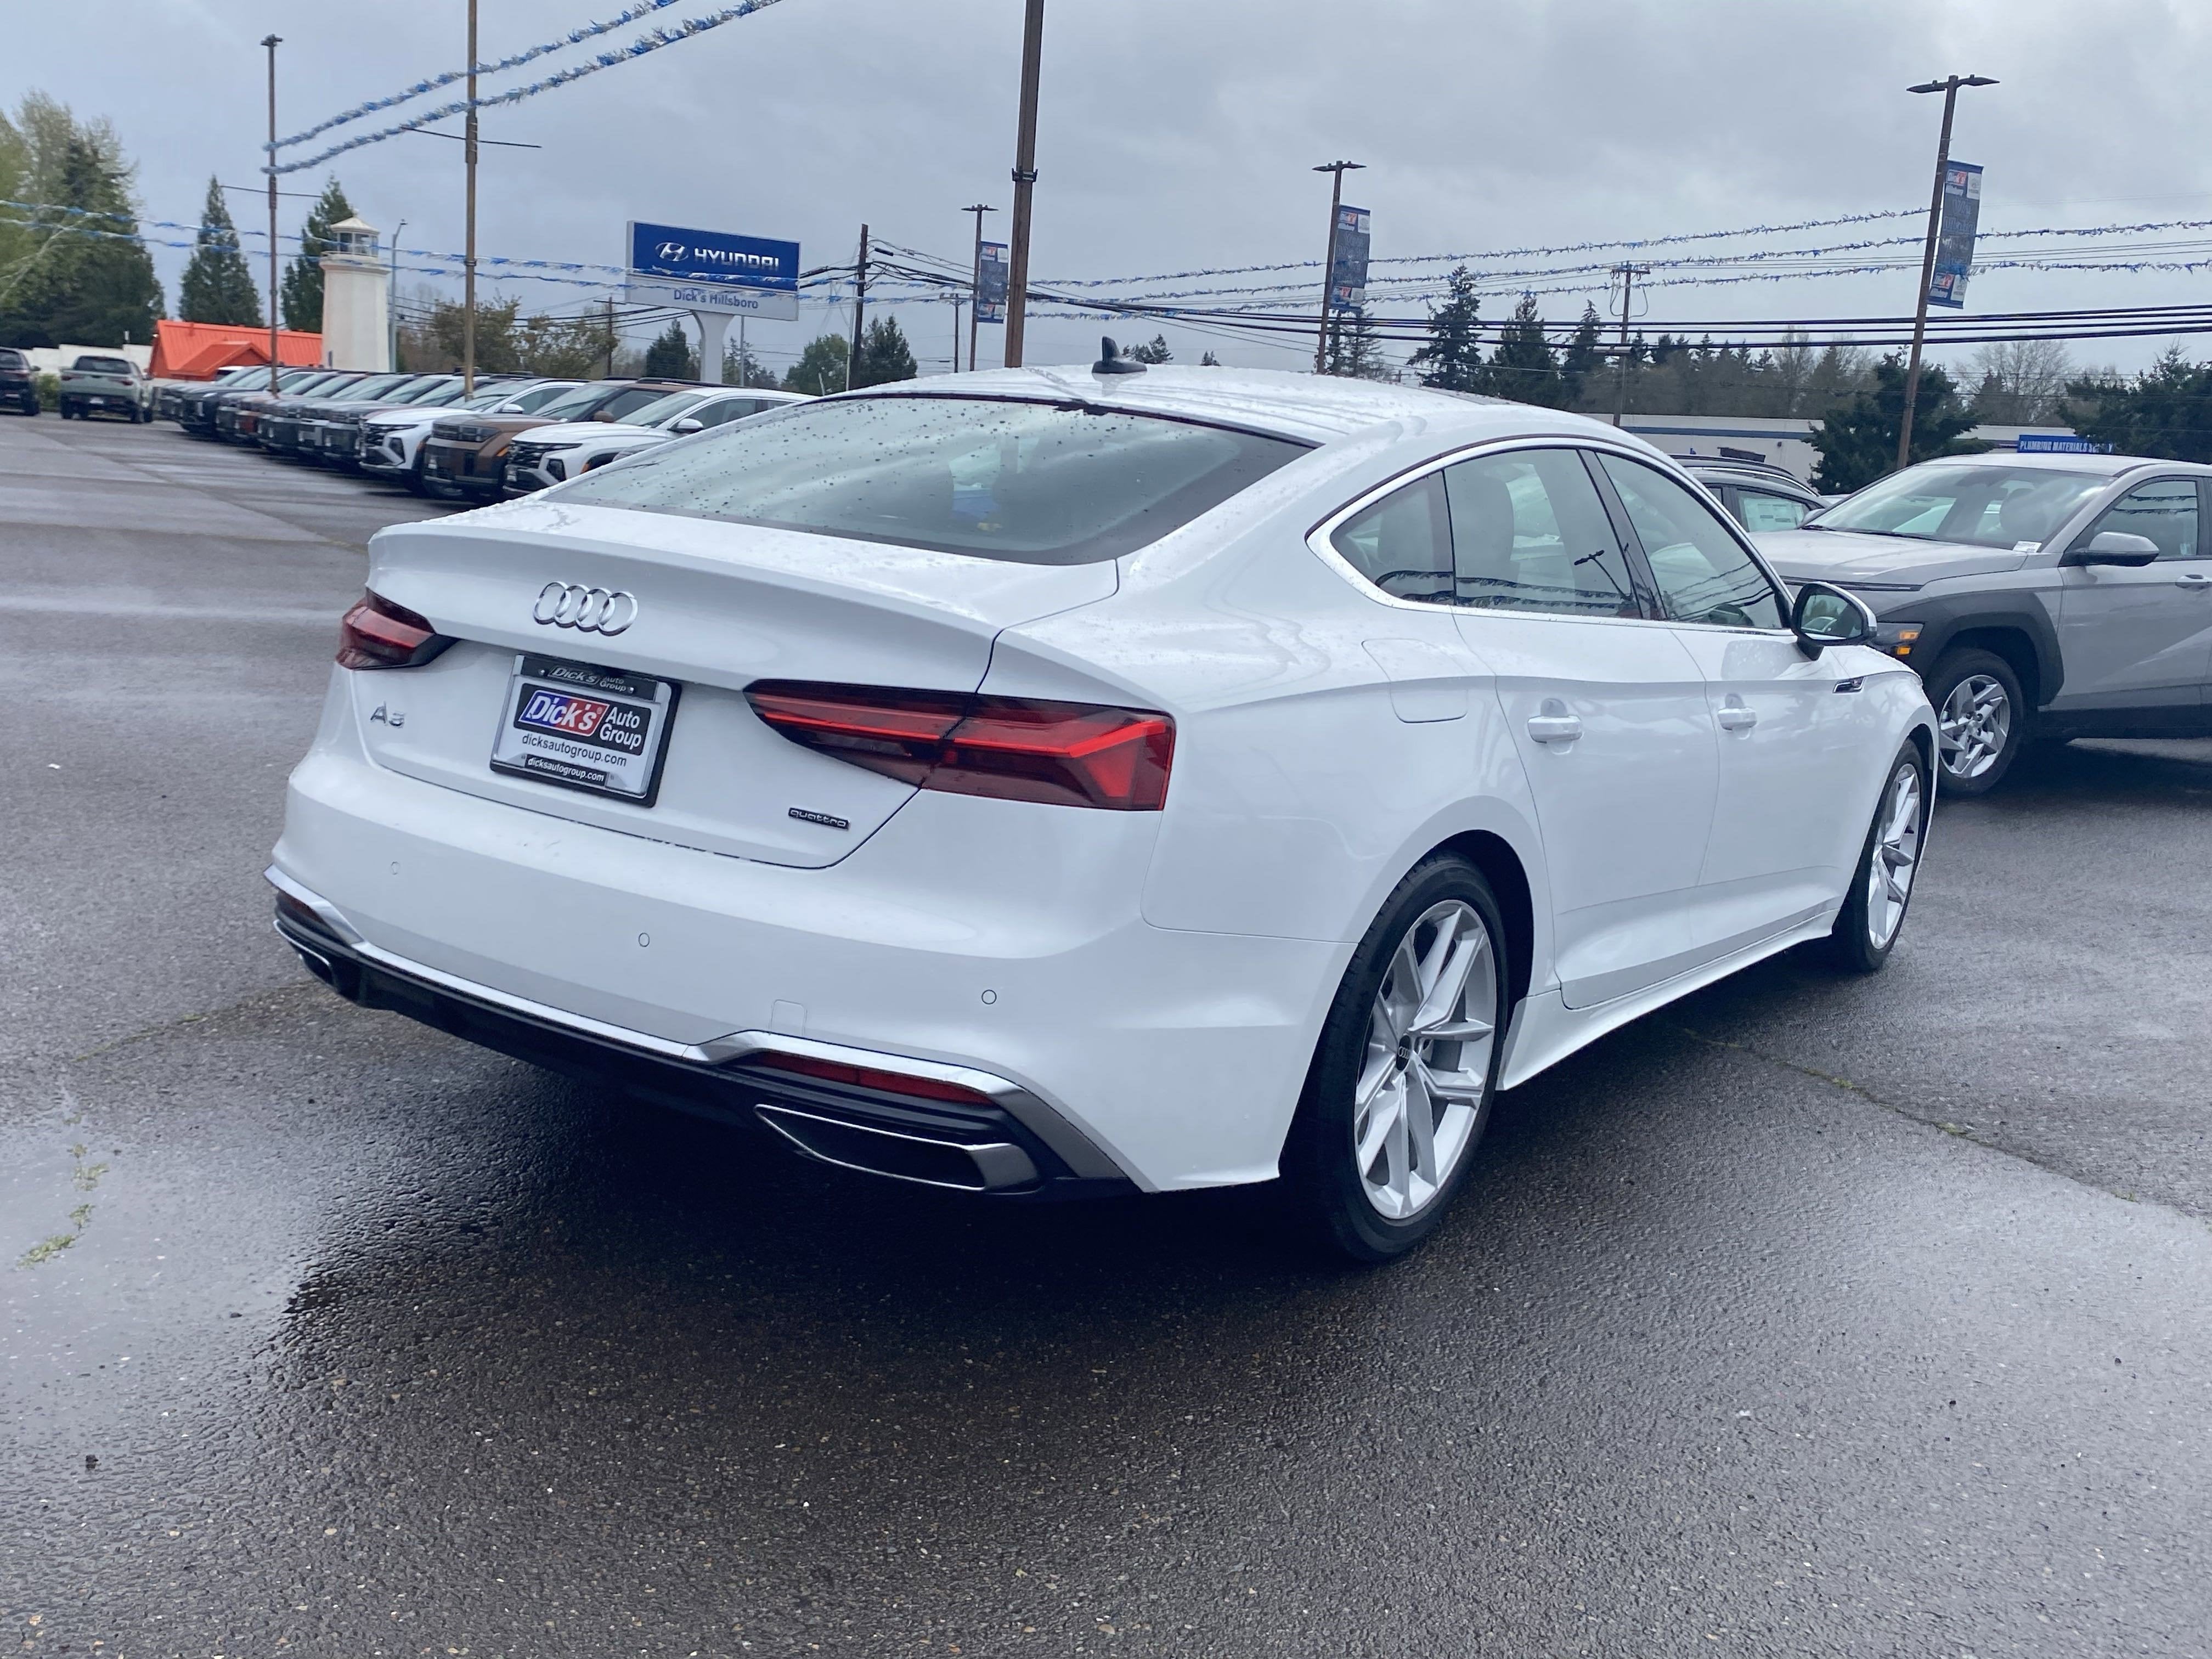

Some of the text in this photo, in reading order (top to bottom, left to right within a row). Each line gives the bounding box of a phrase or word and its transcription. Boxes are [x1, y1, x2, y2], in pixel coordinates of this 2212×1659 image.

[694, 247, 780, 270] HYUNDAI
[709, 293, 759, 309] Hillsboro
[2020, 441, 2052, 450] PLUMBING
[2052, 442, 2088, 452] MATERIALS
[600, 680, 627, 692] Group
[605, 706, 641, 729] Auto
[599, 723, 642, 750] Group
[522, 733, 627, 767] dicksautogroup.com
[528, 758, 604, 782] dicksautogroup.com
[790, 809, 847, 827] quattro
